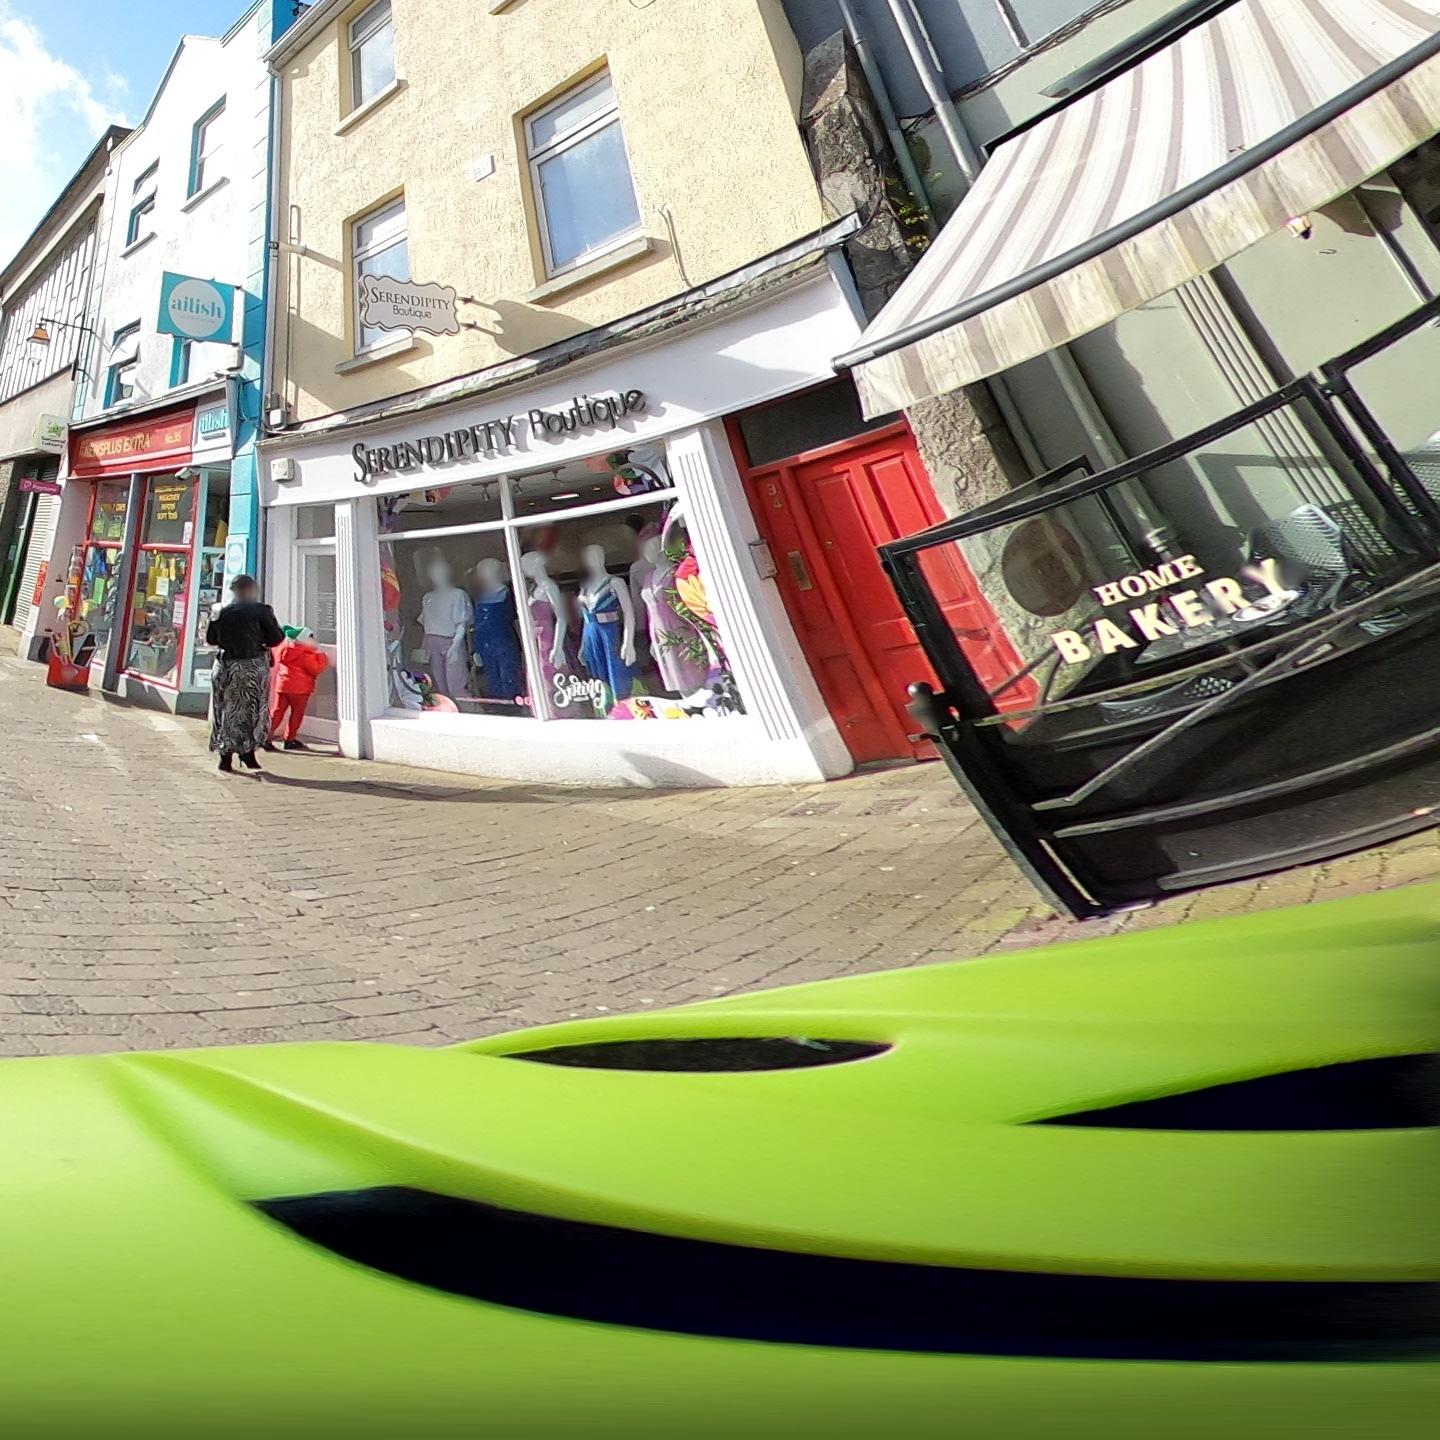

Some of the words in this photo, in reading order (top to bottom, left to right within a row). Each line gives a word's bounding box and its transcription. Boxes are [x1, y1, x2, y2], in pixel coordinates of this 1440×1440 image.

[171, 296, 222, 319] ailish
[370, 287, 450, 310] SERENDIPITY
[392, 305, 432, 320] Boutique
[122, 432, 151, 453] EXTRA
[351, 415, 517, 483] SERENDIPITY
[528, 389, 647, 440] Boutique
[1093, 554, 1205, 607] HOME
[1050, 558, 1288, 665] BAKERY
[553, 672, 606, 709] Spring
